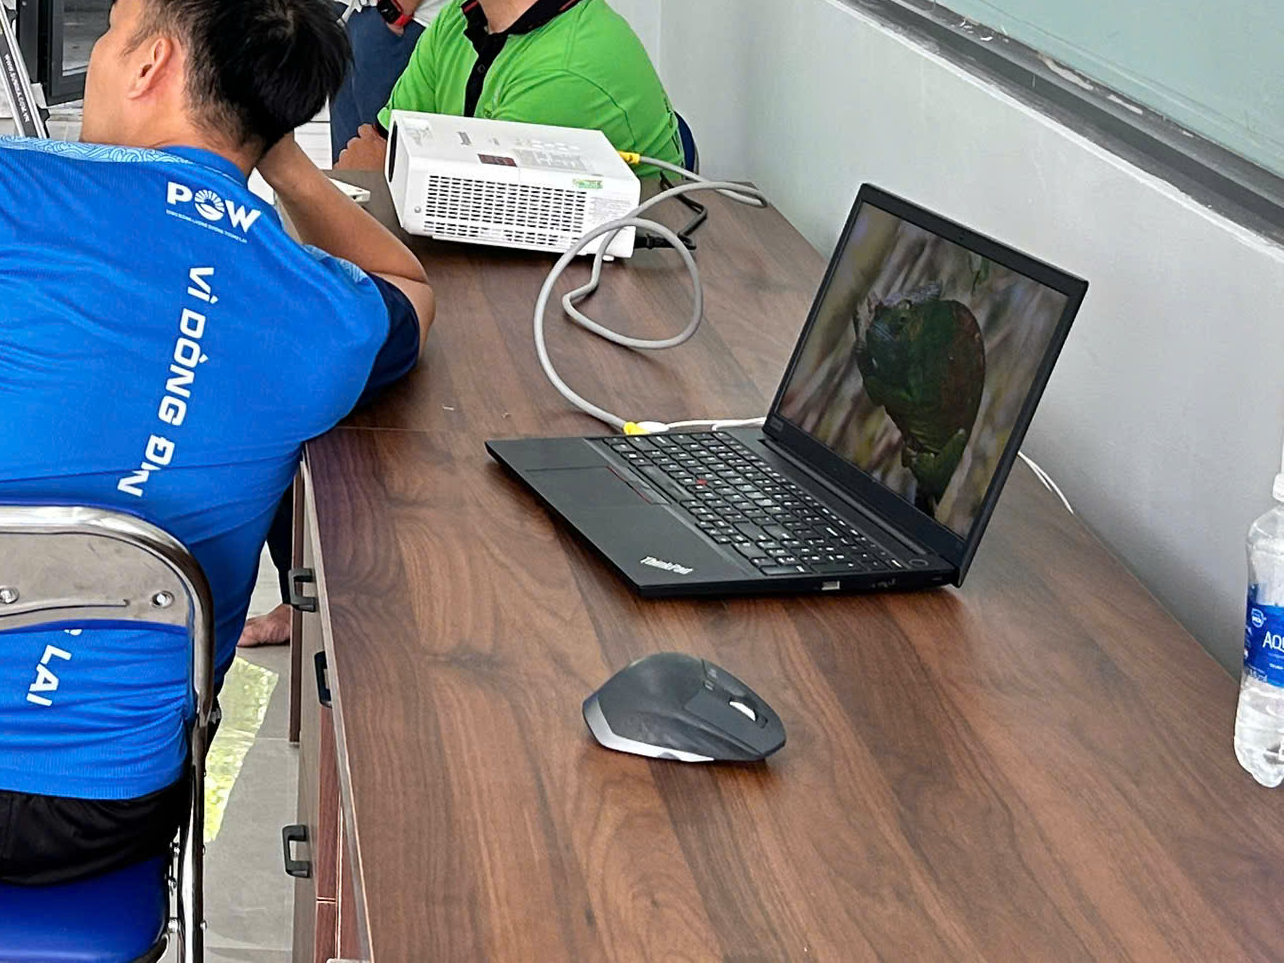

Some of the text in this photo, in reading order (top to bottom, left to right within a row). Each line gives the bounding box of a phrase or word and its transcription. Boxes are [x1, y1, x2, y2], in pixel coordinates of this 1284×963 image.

[166, 181, 261, 234] POW
[187, 266, 219, 304] VÌ
[158, 307, 209, 426] DÒNG
[26, 644, 72, 707] LAI
